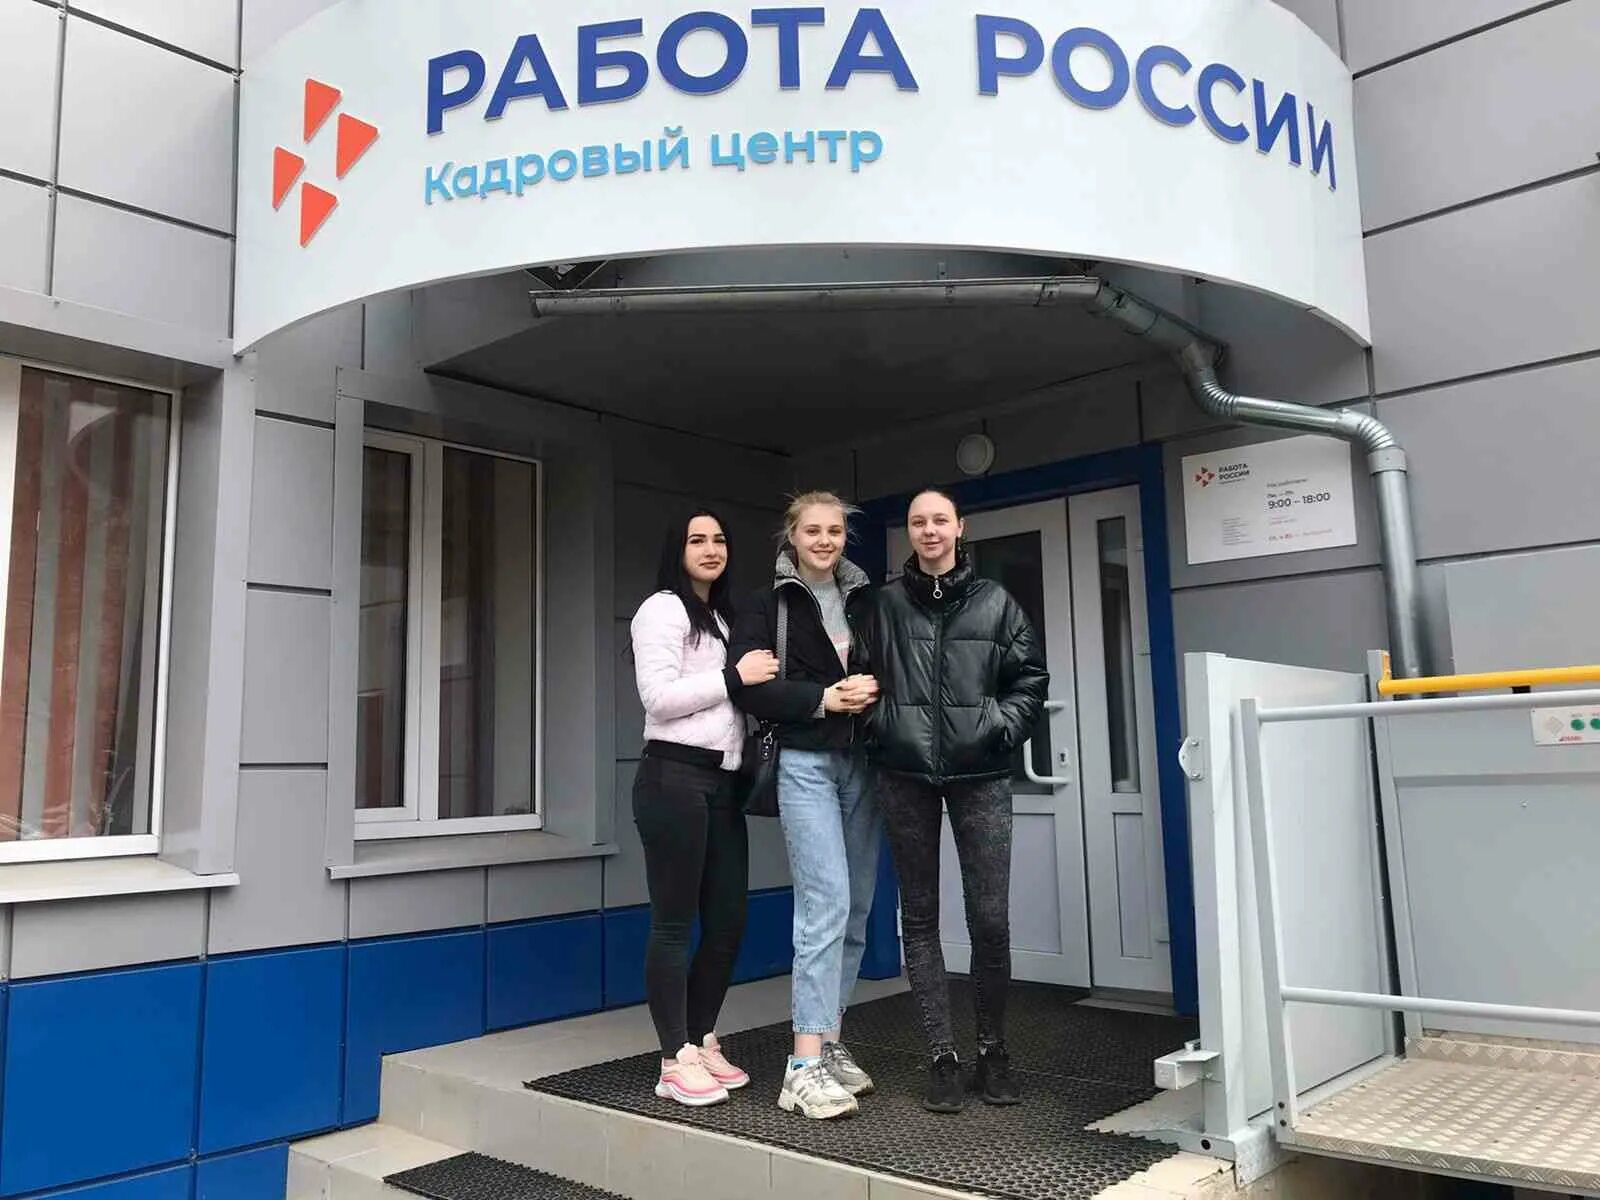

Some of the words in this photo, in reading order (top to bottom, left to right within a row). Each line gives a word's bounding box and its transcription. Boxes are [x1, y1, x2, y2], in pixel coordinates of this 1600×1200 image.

[426, 7, 919, 135] РАБОТА
[975, 14, 1337, 192] РОССИИ
[424, 125, 691, 206] Кадровый
[711, 129, 884, 173] центр
[1218, 463, 1249, 473] РАБОТА
[1218, 470, 1250, 480] РОССИИ
[1268, 498, 1292, 510] 9:00
[1302, 492, 1330, 504] 18:00
